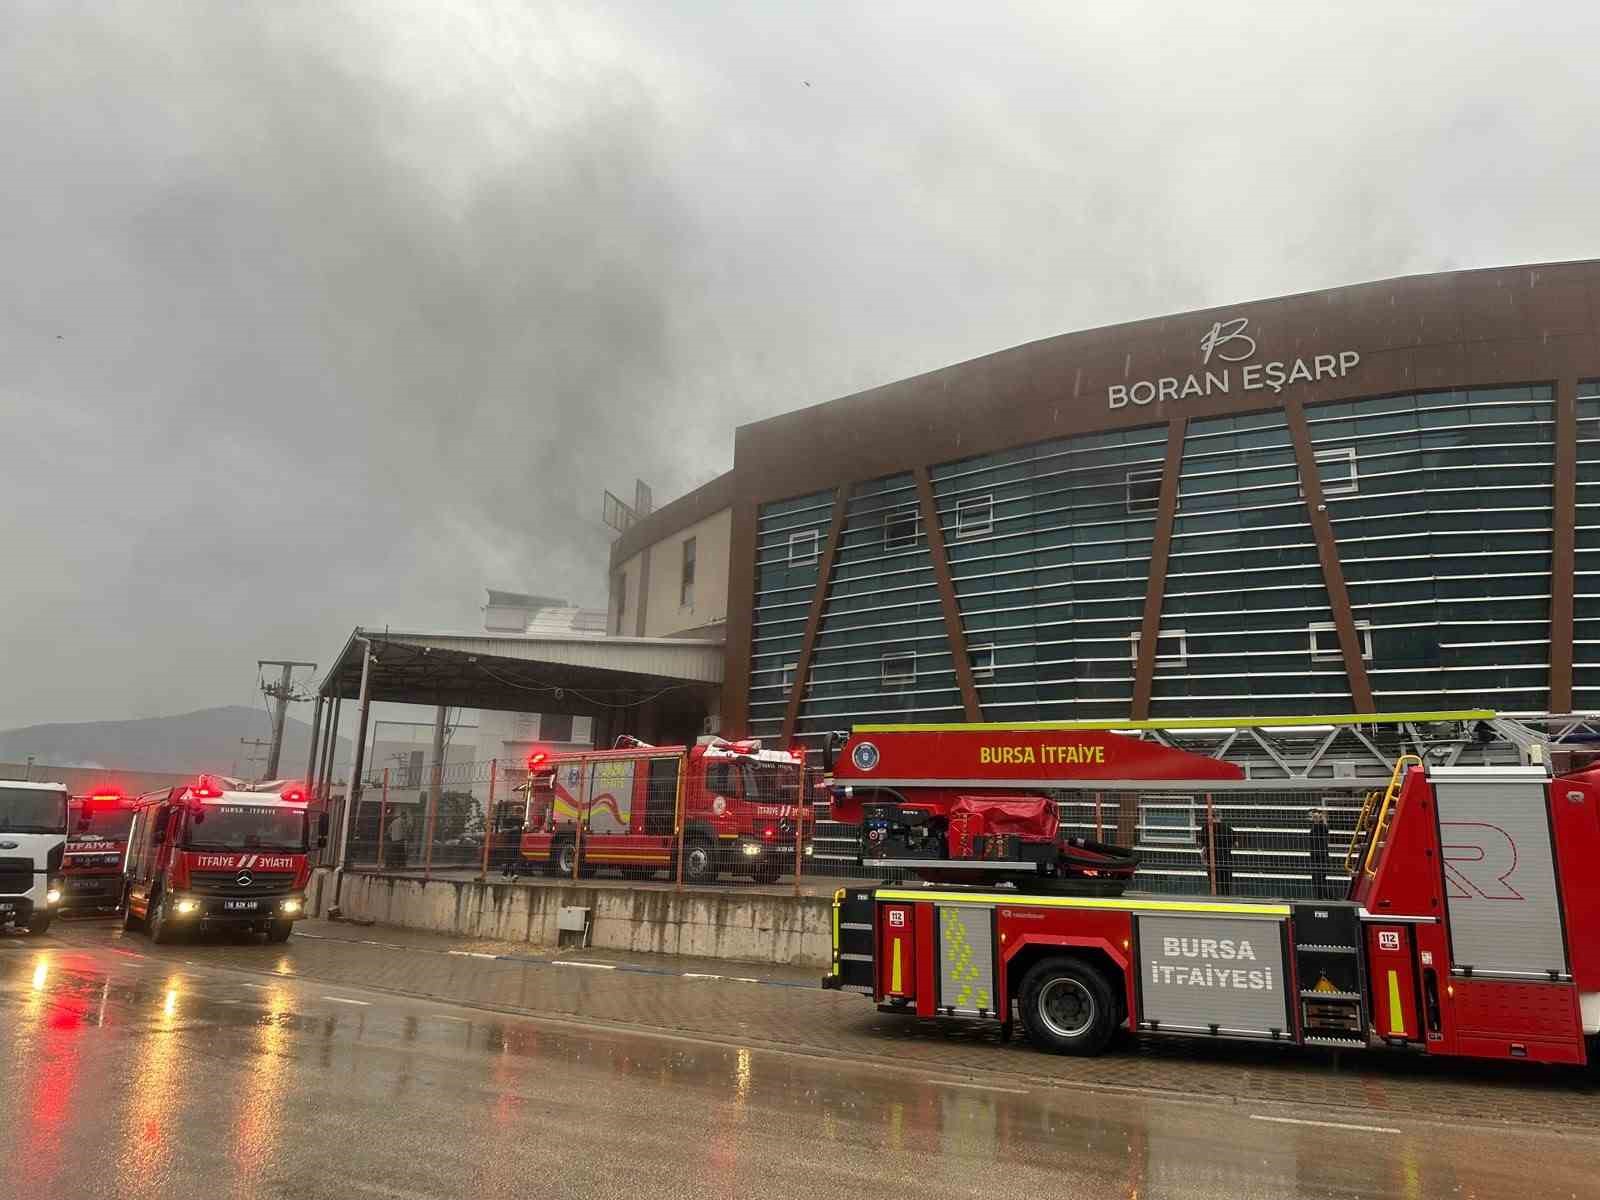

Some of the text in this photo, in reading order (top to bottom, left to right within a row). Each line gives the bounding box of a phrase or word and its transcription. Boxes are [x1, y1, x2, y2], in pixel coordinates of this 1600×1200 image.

[1108, 350, 1360, 409] BORAN EŞARP
[980, 743, 1105, 764] BURSA İTFAİYE
[197, 854, 235, 867] İTFAİYE
[891, 912, 902, 920] 112
[1163, 937, 1256, 960] BURSA
[1381, 933, 1397, 943] 112
[1151, 960, 1273, 990] İTFAİYESİ
